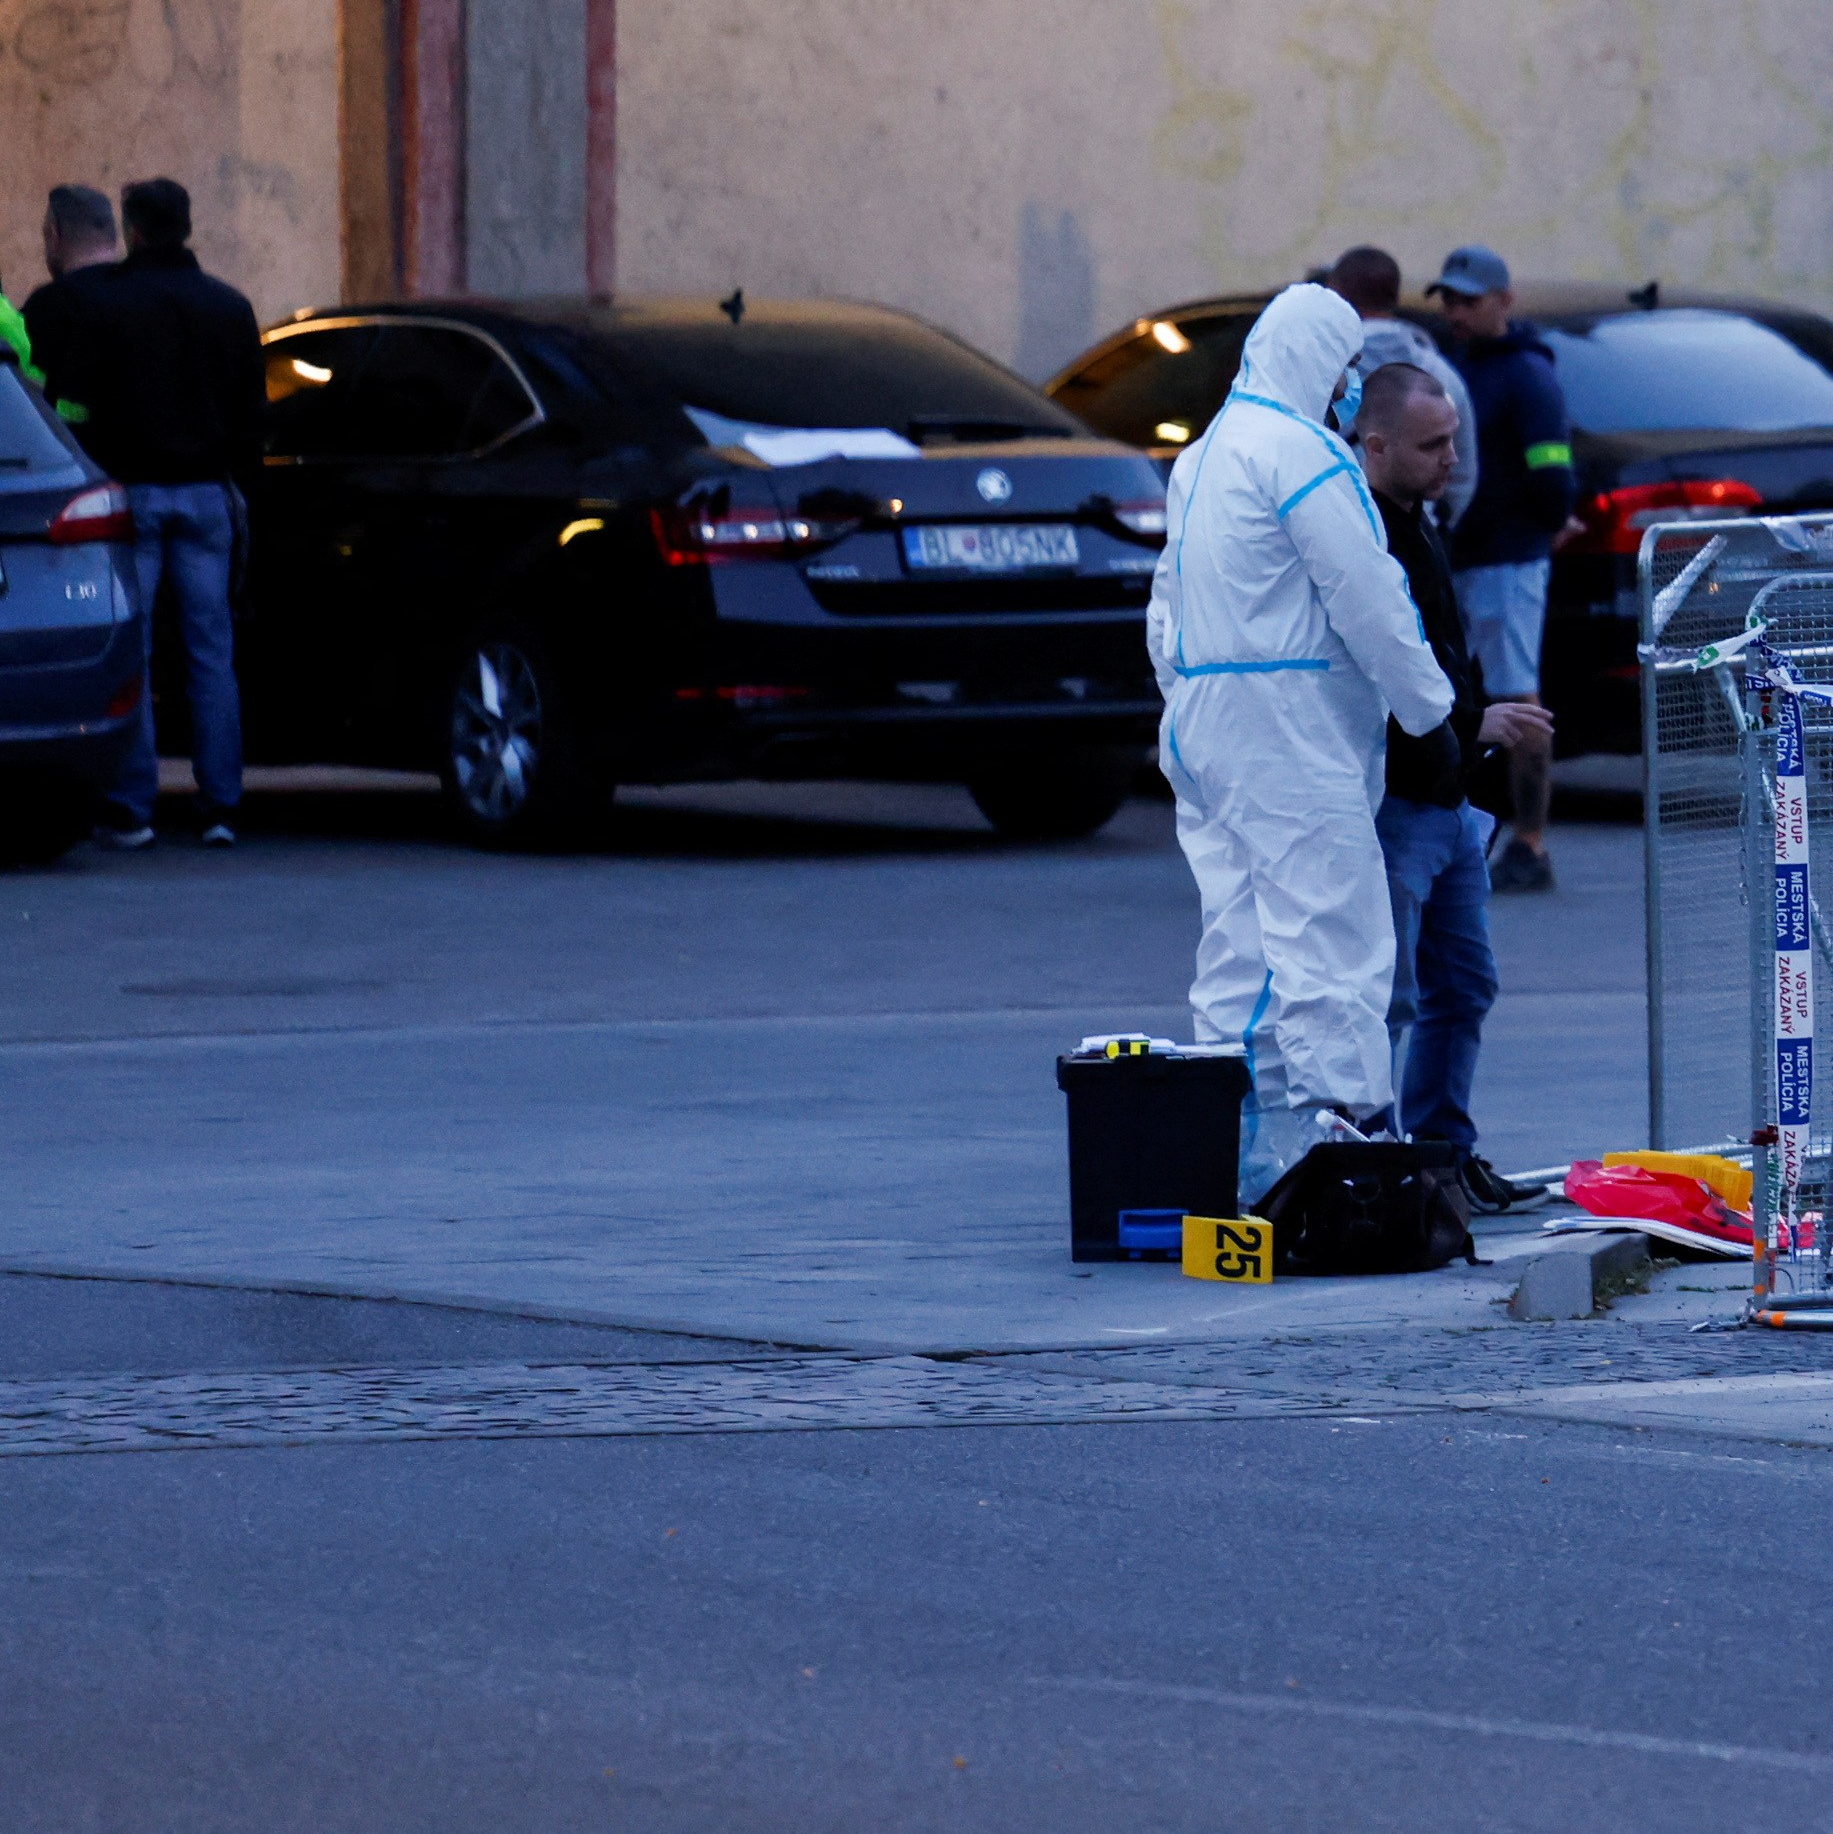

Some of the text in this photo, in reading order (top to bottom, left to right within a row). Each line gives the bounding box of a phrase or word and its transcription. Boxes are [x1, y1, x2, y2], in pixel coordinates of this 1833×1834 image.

[1775, 781, 1790, 861] ZAKÁZANÝ
[1790, 797, 1803, 845] VSTUP
[1775, 878, 1788, 938] POLÍCIA
[1790, 871, 1807, 944] MESTSKÁ
[1778, 956, 1796, 1035] ZAKÁZANÝ
[1795, 970, 1808, 1019] VSTUP
[1780, 1052, 1797, 1113] POLÍCIA
[1215, 1223, 1262, 1278] 25
